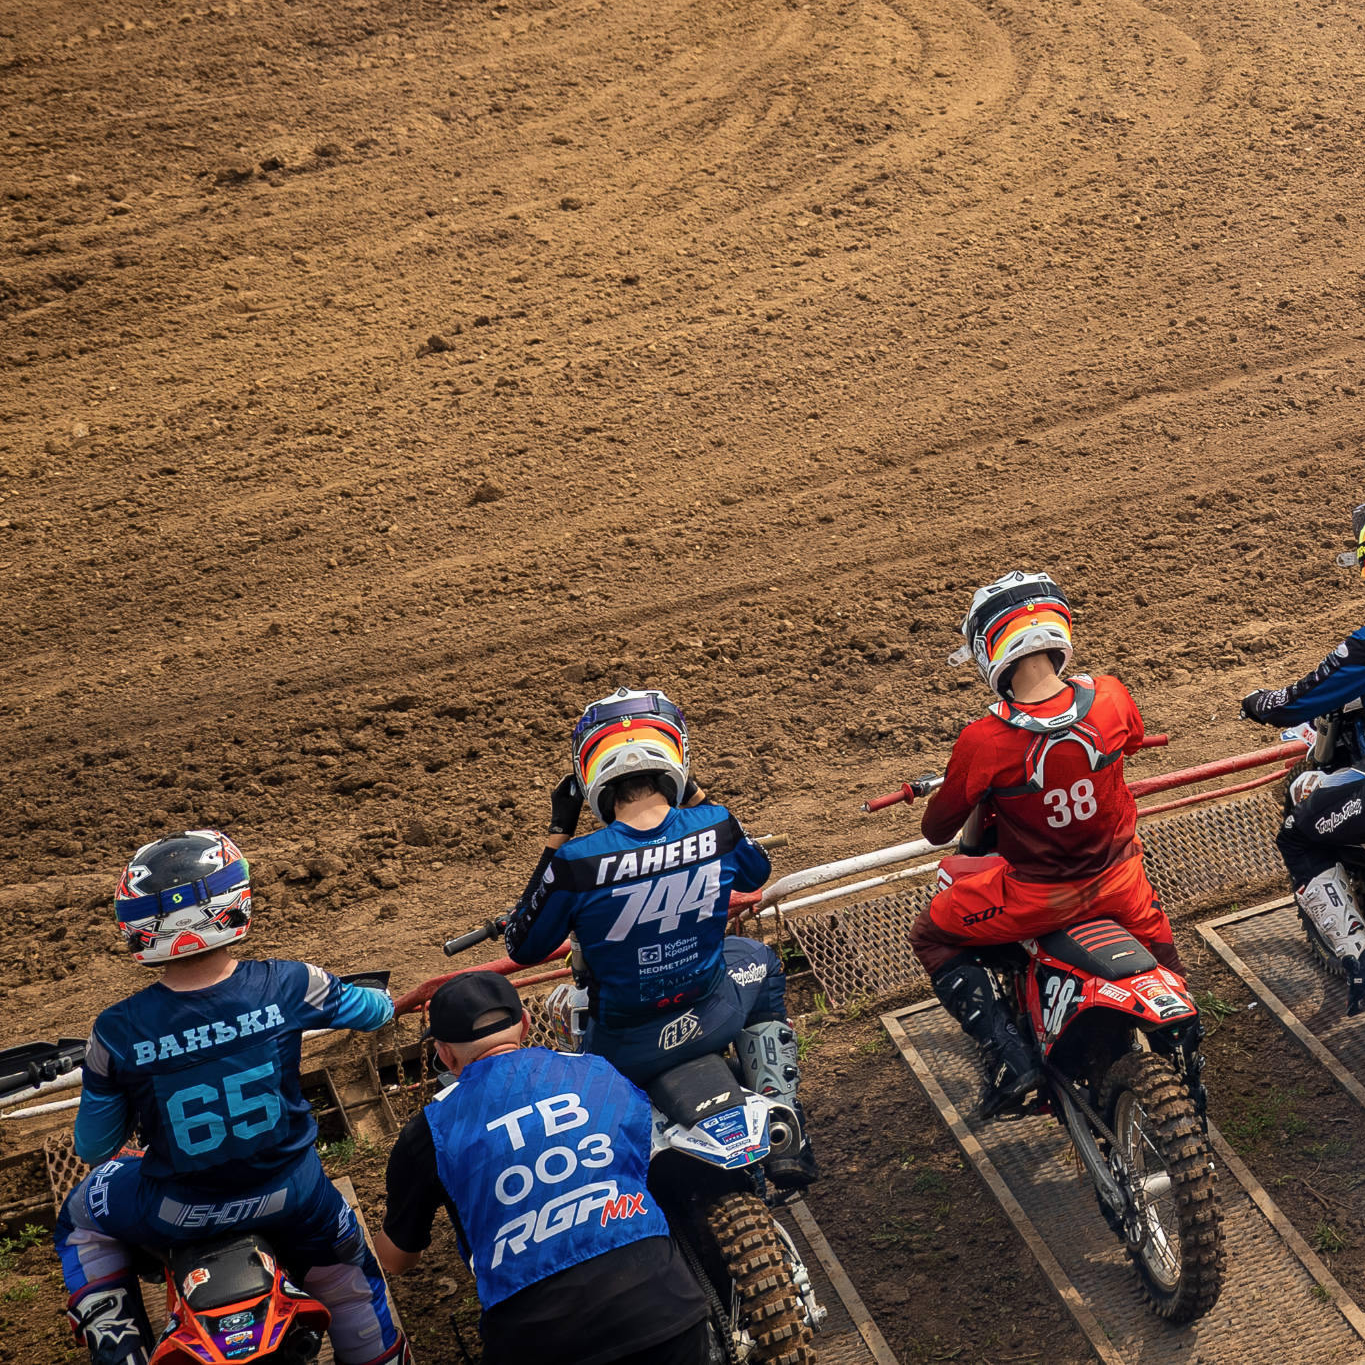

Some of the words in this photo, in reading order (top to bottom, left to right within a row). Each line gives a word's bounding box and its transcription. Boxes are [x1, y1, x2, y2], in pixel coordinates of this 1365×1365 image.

[1043, 778, 1098, 829] 38
[595, 829, 718, 886] ГАНЕЕВ
[604, 859, 721, 942] 744
[639, 953, 698, 975] НЕОМЕТРИЯ
[665, 936, 698, 951] Кубань
[665, 942, 698, 958] Кредит
[1098, 983, 1132, 1003] PIRELLI
[133, 1003, 286, 1066] ВАНЬКА
[165, 1061, 282, 1157] 65
[487, 1092, 590, 1151] ТВ
[495, 1133, 615, 1206] 003
[185, 1196, 259, 1228] SHOT
[490, 1180, 618, 1270] RGP
[601, 1191, 649, 1230] MX
